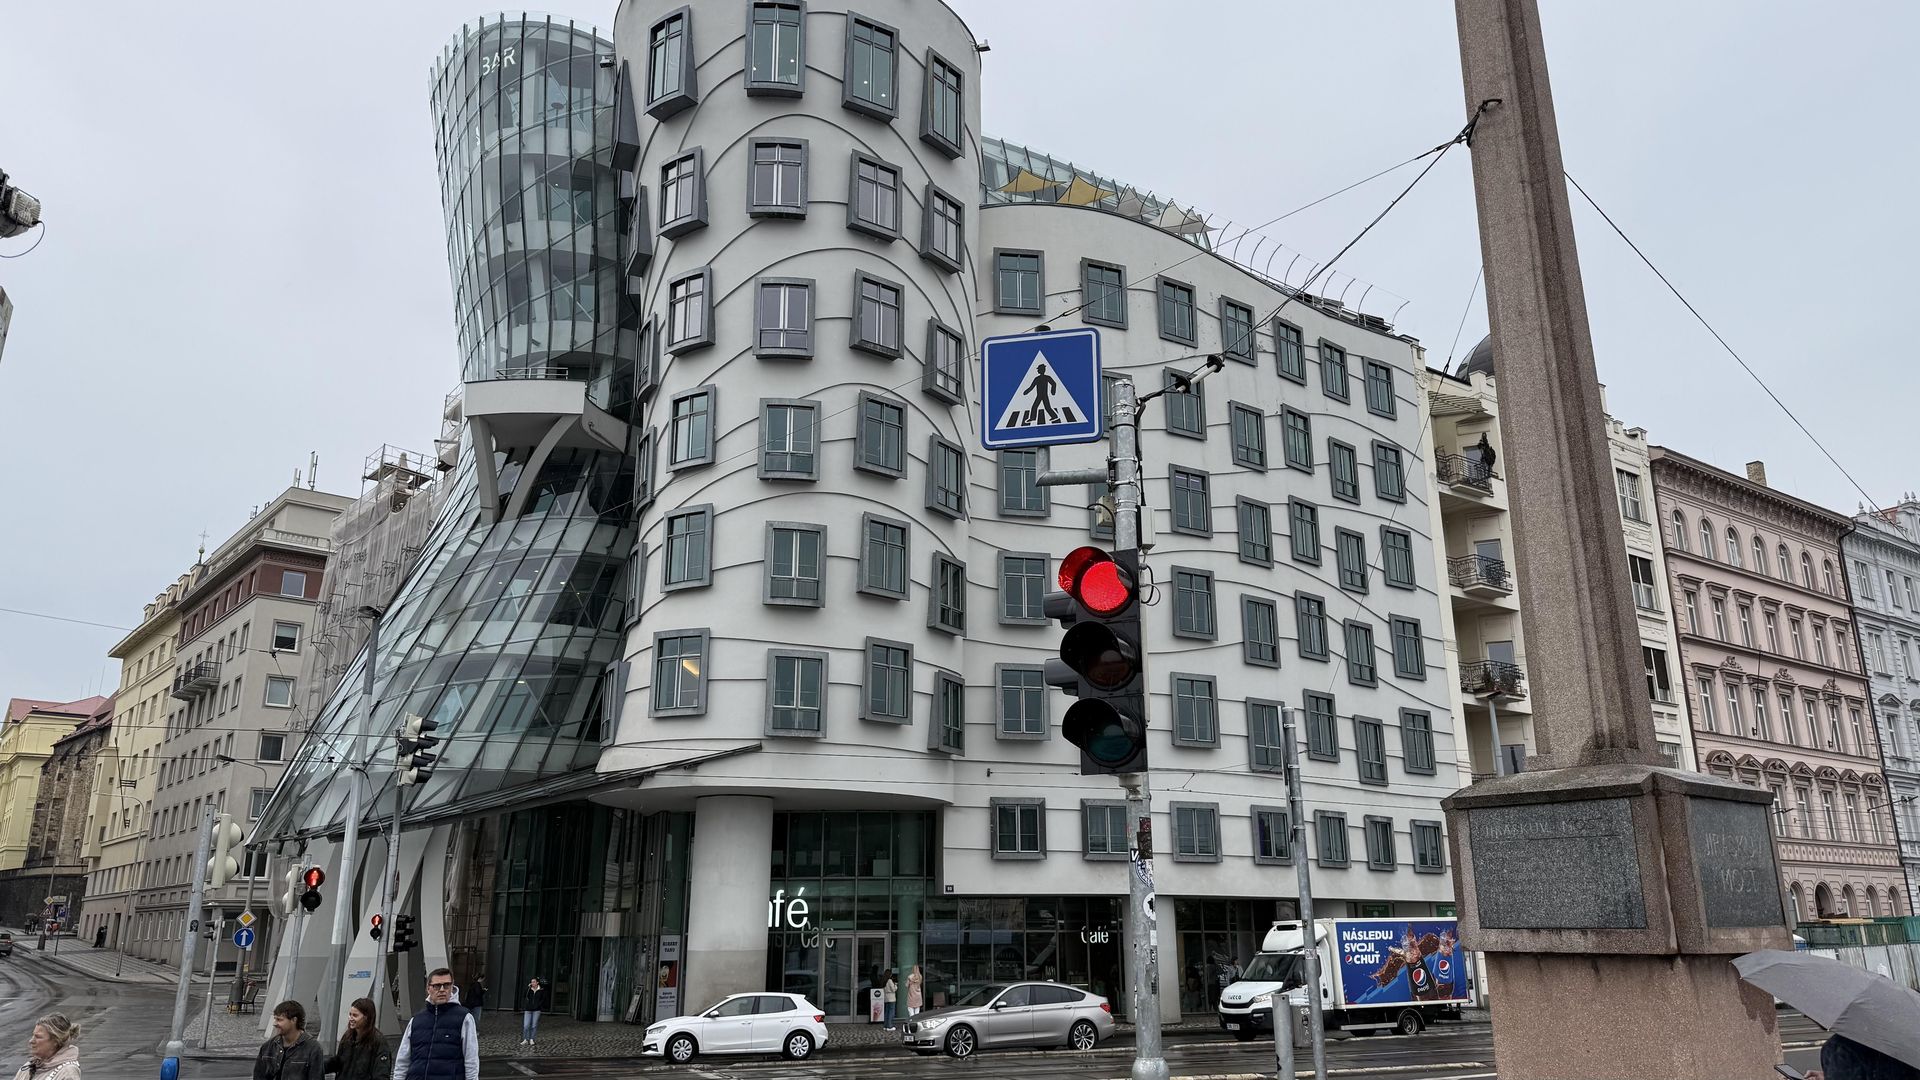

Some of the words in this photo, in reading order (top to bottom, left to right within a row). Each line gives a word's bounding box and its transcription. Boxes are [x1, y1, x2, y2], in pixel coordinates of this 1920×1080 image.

[1342, 928, 1393, 941] NÁSLEDUJ
[1344, 942, 1375, 953] SVOJI
[1353, 950, 1381, 964] CHUŤ
